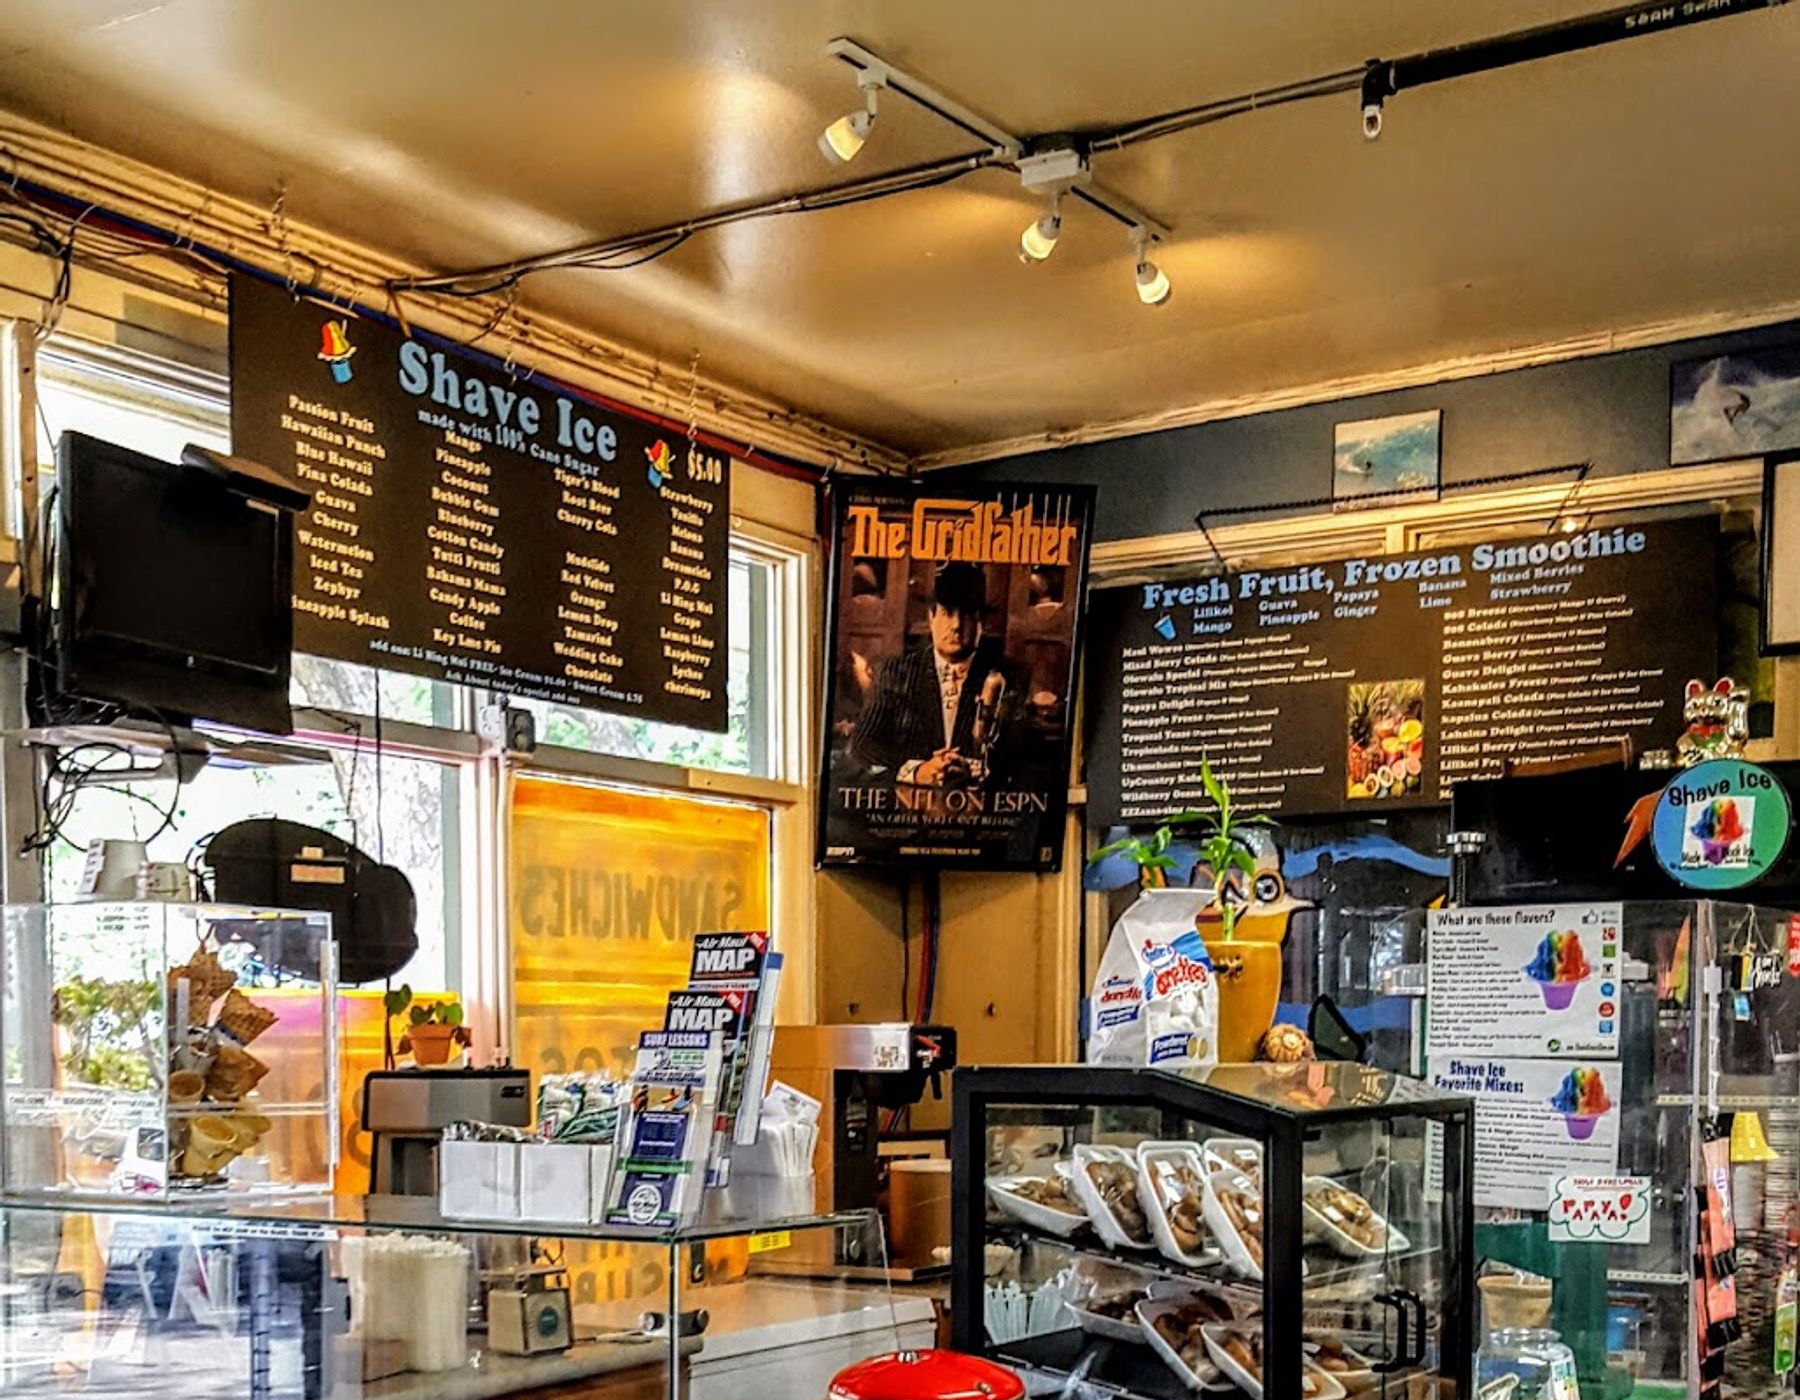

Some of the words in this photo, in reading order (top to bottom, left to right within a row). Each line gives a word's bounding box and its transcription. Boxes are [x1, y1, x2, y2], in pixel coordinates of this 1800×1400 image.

[400, 340, 540, 435] Shave
[557, 398, 617, 462] Ice
[289, 395, 338, 421] Passion
[340, 411, 374, 433] Fruit
[281, 415, 343, 445] Hawaiian
[347, 435, 386, 459] Punch
[419, 408, 455, 432] made
[460, 421, 492, 442] with
[530, 443, 560, 464] Cane
[564, 452, 600, 478] Sugar
[445, 431, 482, 454] Mango
[296, 441, 325, 461] Blue
[328, 450, 373, 476] Hawaii
[436, 448, 491, 476] Pineapple
[688, 450, 722, 485] $5.00
[331, 473, 373, 496] Colada
[442, 470, 489, 495] Coconut
[554, 468, 589, 490] Tiger's
[592, 479, 620, 499] Blood
[316, 491, 356, 512] Guava
[432, 487, 470, 510] Bubble
[473, 499, 500, 517] Gum
[562, 491, 587, 510] Root
[589, 498, 612, 515] Beer
[660, 486, 713, 514] Strawberry
[313, 511, 359, 536] Cherry
[438, 509, 494, 537] Blueberry
[557, 509, 594, 531] Cherry
[596, 518, 618, 536] Cola
[671, 507, 703, 527] Vanilla
[428, 525, 467, 547] Cotton
[469, 536, 504, 558] Candy
[848, 505, 906, 559] The
[911, 498, 1077, 566] Gridfather
[298, 530, 374, 561] Watermelon
[670, 541, 704, 560] Banana
[310, 555, 337, 572] Iced
[340, 561, 363, 579] Tea
[432, 546, 463, 566] Tutti
[466, 555, 500, 575] Frutti
[1142, 577, 1230, 609] Fresh
[1238, 566, 1335, 599] Fruit,
[1343, 554, 1461, 588] Frozen
[1471, 527, 1646, 572] Smoothie
[427, 566, 471, 588] Bahama
[474, 578, 506, 596] Mama
[561, 570, 581, 585] Red
[1418, 578, 1467, 593] Banana
[1490, 569, 1530, 585] Mixed
[1534, 564, 1584, 582] Berries
[314, 576, 360, 599] Zephyr
[1333, 588, 1379, 604] Papaya
[1490, 581, 1572, 600] Strawberry
[291, 595, 346, 619] ineapple
[349, 608, 389, 629] Splash
[429, 588, 465, 609] Candy
[468, 597, 500, 615] Apple
[571, 591, 606, 610] Orange
[1259, 599, 1297, 612] Guava
[1333, 604, 1378, 618] Ginger
[1419, 597, 1451, 608] Lime
[450, 613, 485, 630] Coffee
[558, 606, 591, 623] Lemon
[594, 614, 618, 632] Drop
[674, 612, 701, 629] Grape
[1192, 621, 1232, 635] Mango
[1259, 610, 1319, 626] Pineapple
[433, 628, 455, 646] Key
[485, 639, 501, 654] Pie
[565, 626, 612, 646] Tamarind
[660, 627, 690, 643] Lemon
[692, 634, 714, 649] Lime
[554, 642, 597, 665] Wedding
[599, 652, 623, 667] Cake
[664, 646, 711, 667] Raspberry
[1123, 660, 1152, 671] Mixed
[1154, 657, 1182, 668] Berry
[1184, 655, 1217, 665] Colada
[1483, 649, 1517, 662] Berry
[565, 663, 613, 683] Chocolate
[1482, 663, 1526, 677] Delight
[1159, 699, 1195, 711] Delight
[1122, 716, 1169, 729] Pineapple
[1490, 725, 1534, 737] Delight
[1483, 742, 1517, 753] Berry
[1668, 779, 1730, 806] Shave
[1739, 769, 1771, 789] Ice
[839, 787, 887, 810] THE
[895, 788, 937, 811] NFL
[946, 790, 984, 812] ON
[993, 792, 1048, 813] ESPN
[1437, 914, 1464, 926] What
[1467, 915, 1483, 925] are
[1485, 912, 1511, 924] these
[1515, 910, 1556, 923] flavors?
[701, 937, 718, 949] Air
[718, 936, 748, 948] Maui
[695, 948, 755, 972] MAP
[675, 996, 694, 1007] Air
[693, 995, 726, 1007] Maui
[668, 1008, 733, 1031] MAP
[643, 1034, 667, 1047] SURF
[668, 1033, 707, 1047] LESSONS
[1450, 1061, 1485, 1076] Shave
[1488, 1062, 1506, 1077] Ice
[1434, 1075, 1482, 1092] Favorite
[1484, 1079, 1524, 1093] Mixes:
